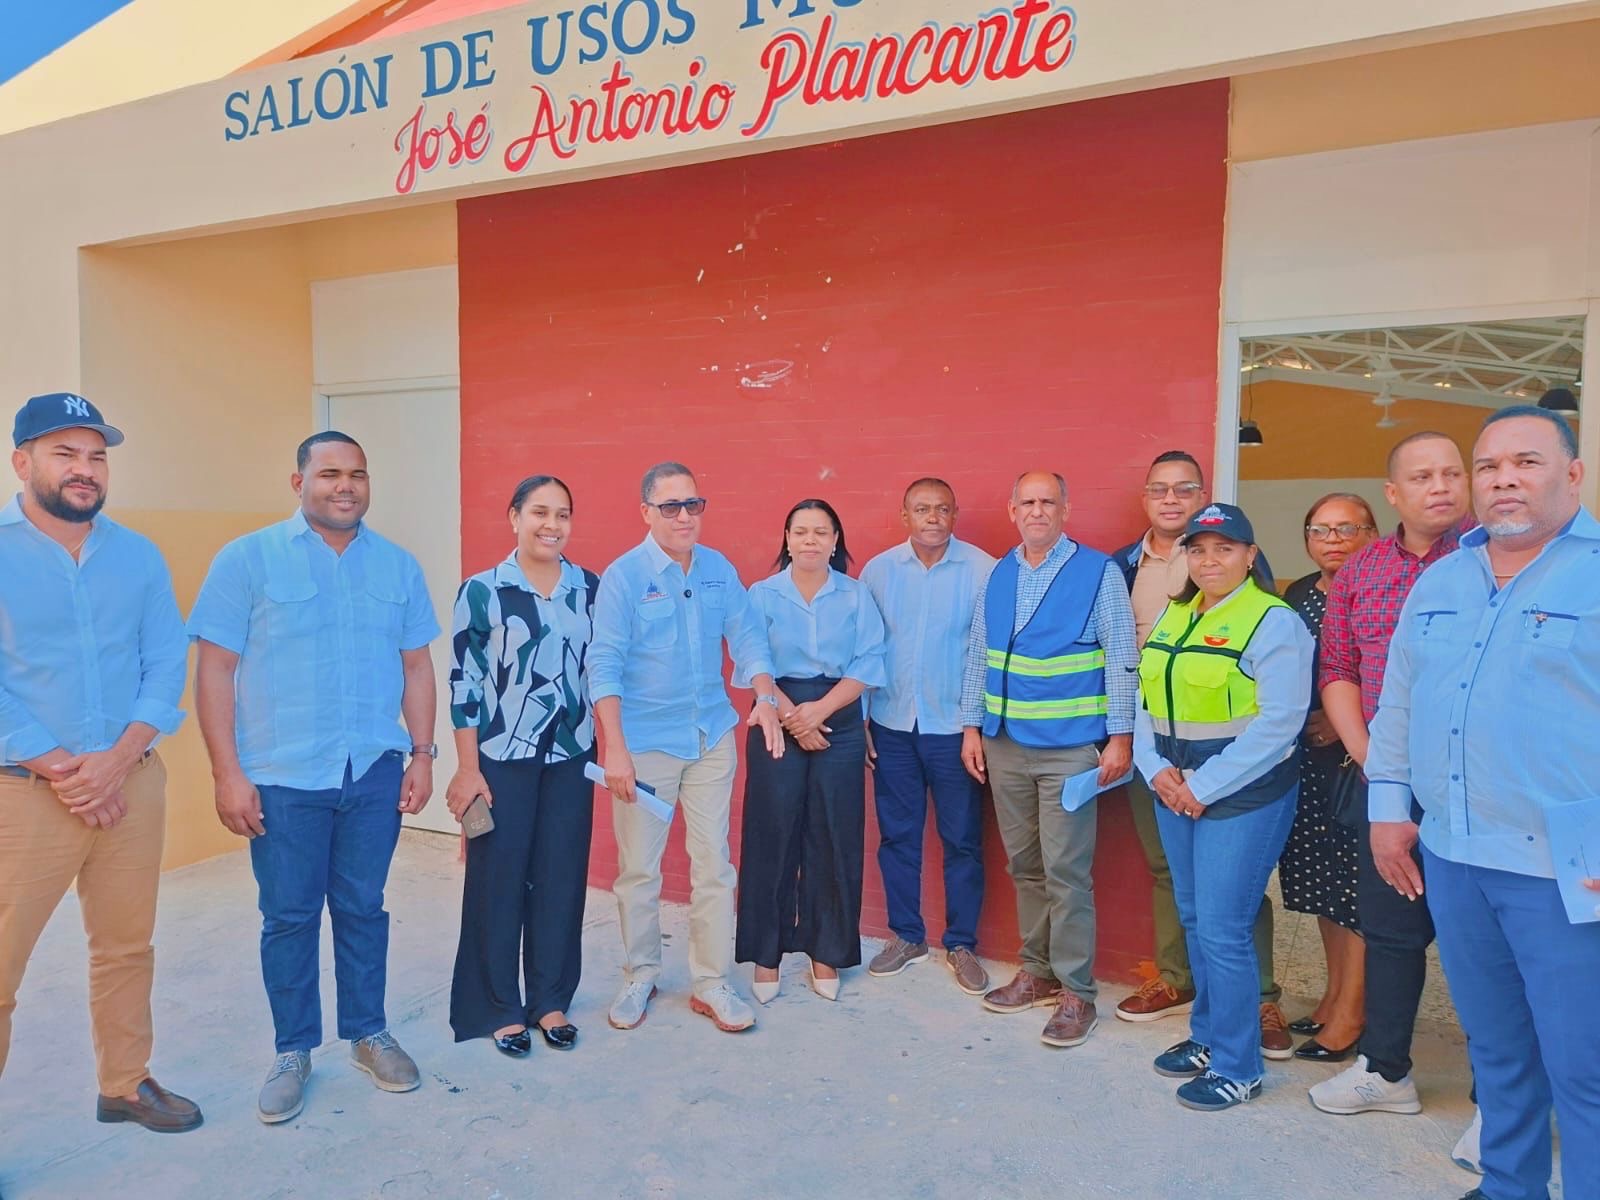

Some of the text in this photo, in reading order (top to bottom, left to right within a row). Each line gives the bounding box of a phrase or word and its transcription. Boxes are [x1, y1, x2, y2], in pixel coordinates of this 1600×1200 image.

[224, 0, 696, 142] SALÓN DE USOS
[394, 0, 1076, 194] José Antonio Plancarte
